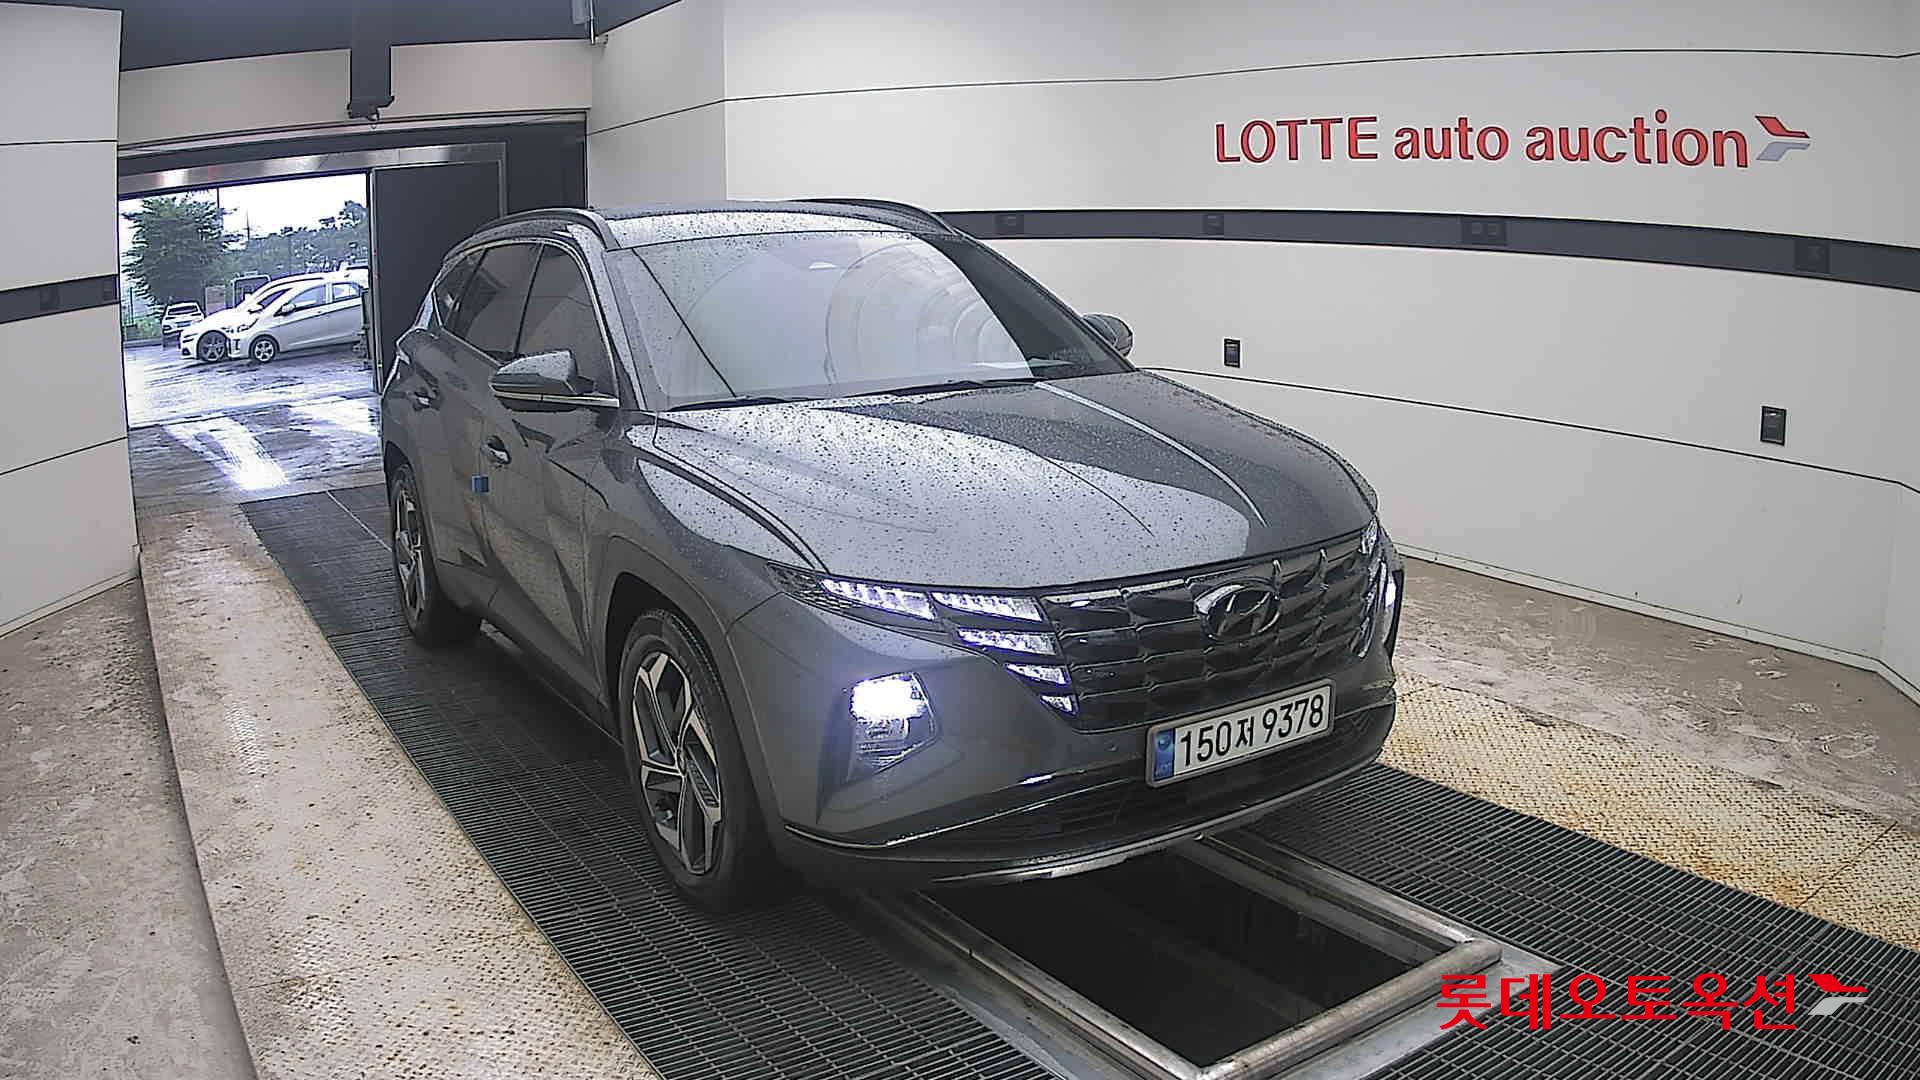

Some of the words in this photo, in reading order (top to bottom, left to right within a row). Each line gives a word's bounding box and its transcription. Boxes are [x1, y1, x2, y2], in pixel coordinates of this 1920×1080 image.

[1215, 116, 1378, 163] LOTTE
[1394, 117, 1510, 161] auto
[1525, 109, 1749, 168] auction
[1262, 694, 1324, 743] 9378
